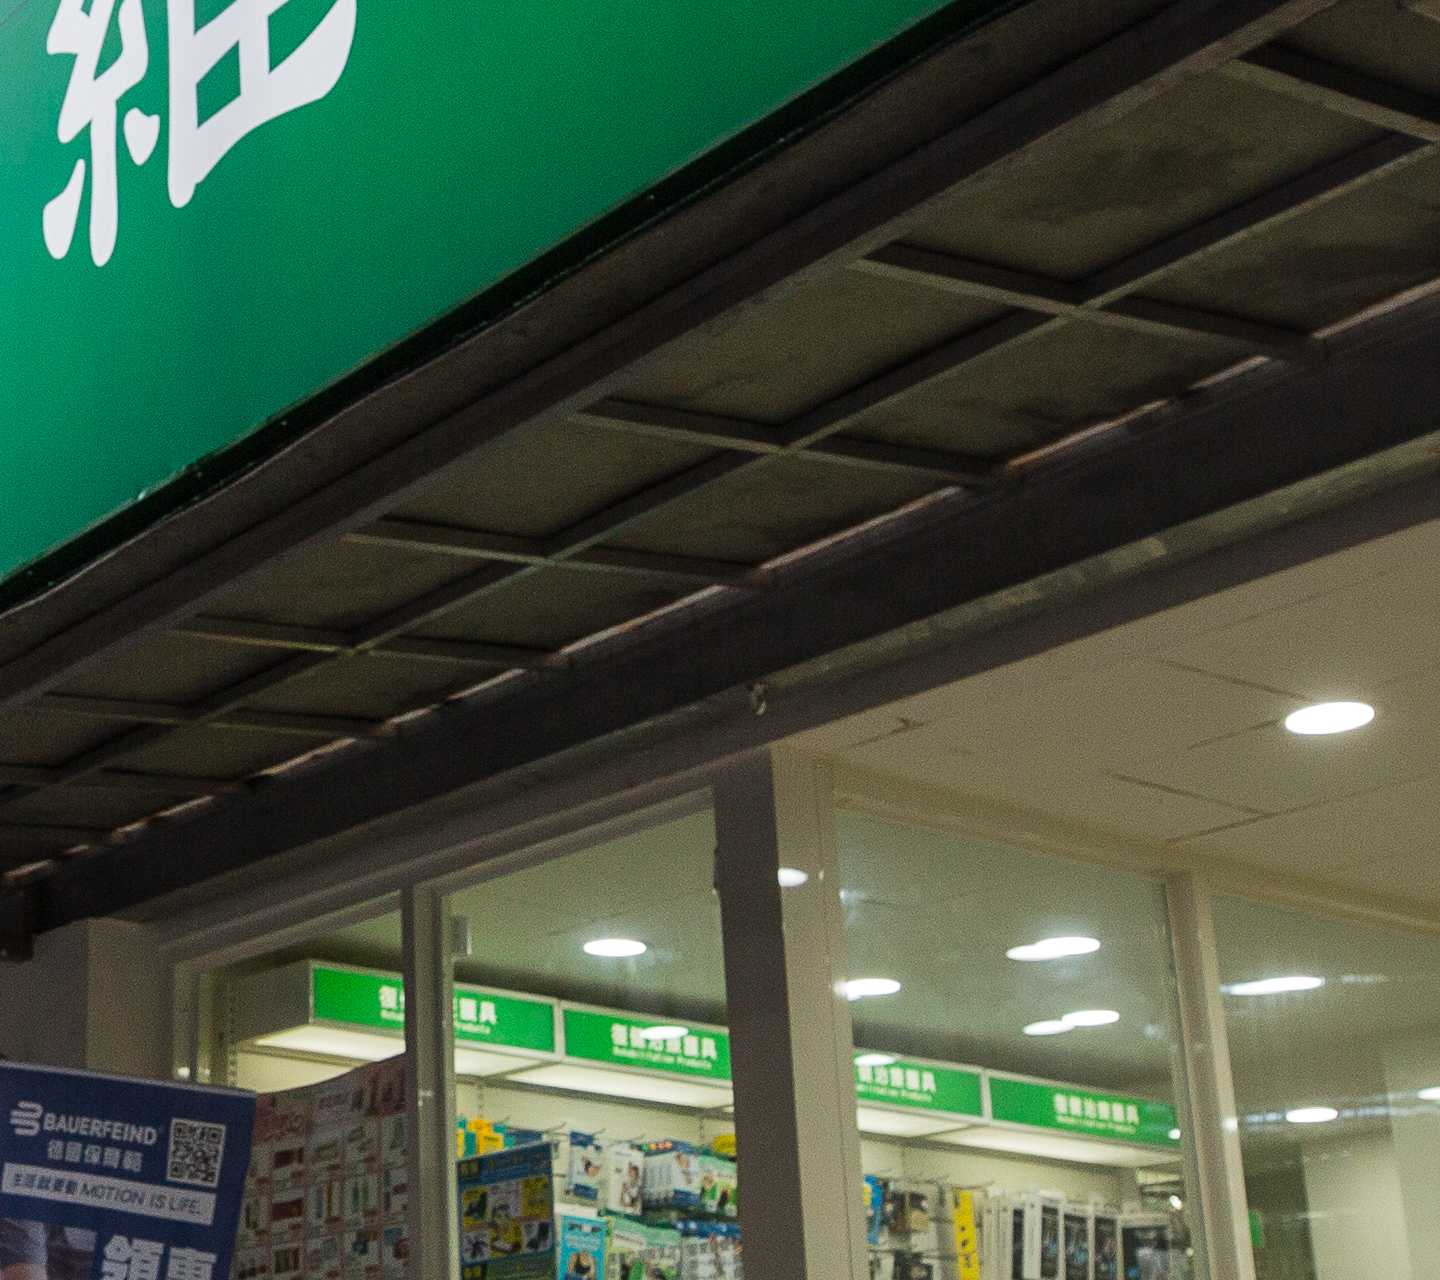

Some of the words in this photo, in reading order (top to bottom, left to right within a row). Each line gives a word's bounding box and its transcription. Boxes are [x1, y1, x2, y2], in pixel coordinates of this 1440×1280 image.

[43, 1112, 158, 1147] BAUERFEIND
[80, 1181, 146, 1206] MOTION
[150, 1193, 167, 1209] IS
